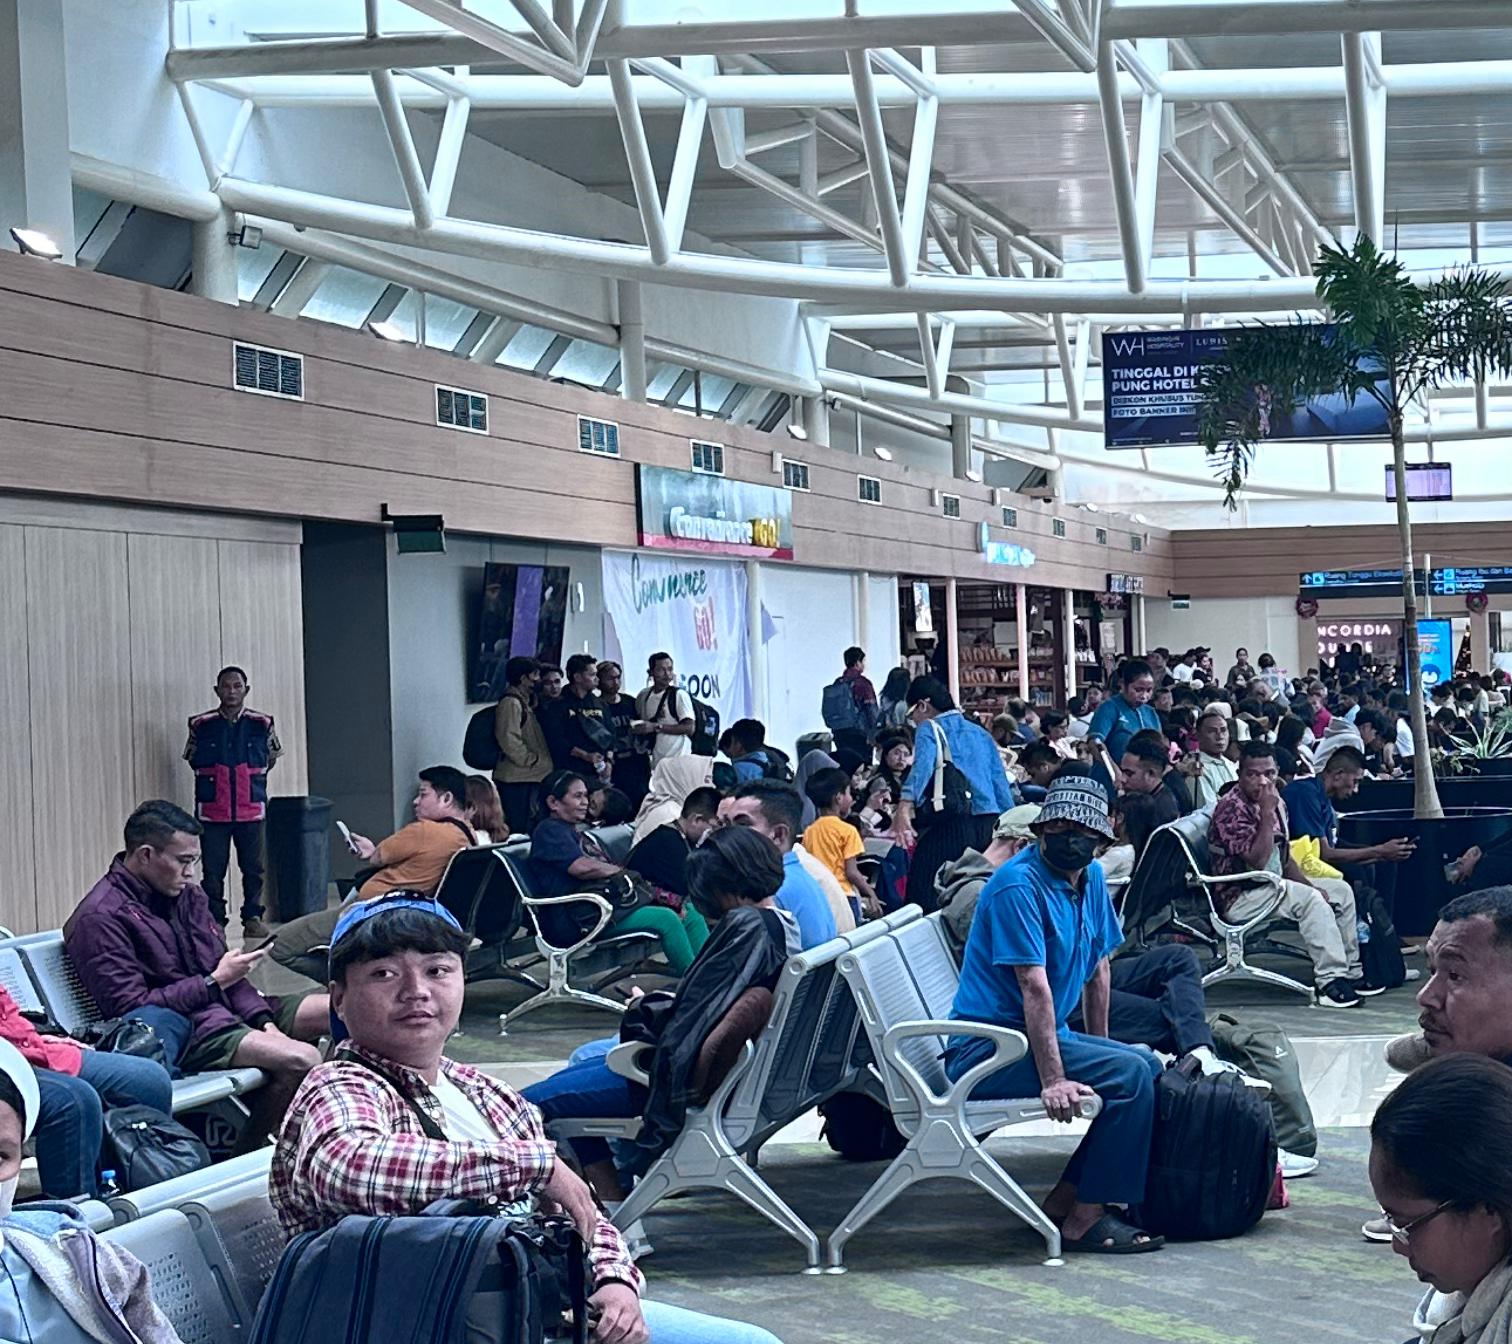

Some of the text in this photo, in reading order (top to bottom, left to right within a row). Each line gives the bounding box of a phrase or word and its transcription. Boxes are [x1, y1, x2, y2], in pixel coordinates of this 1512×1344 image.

[1111, 367, 1171, 379] TINGGAL
[1173, 366, 1188, 377] DI
[1111, 380, 1151, 392] PUNG
[1153, 378, 1198, 390] HOTEL
[1114, 408, 1137, 416] FOTO
